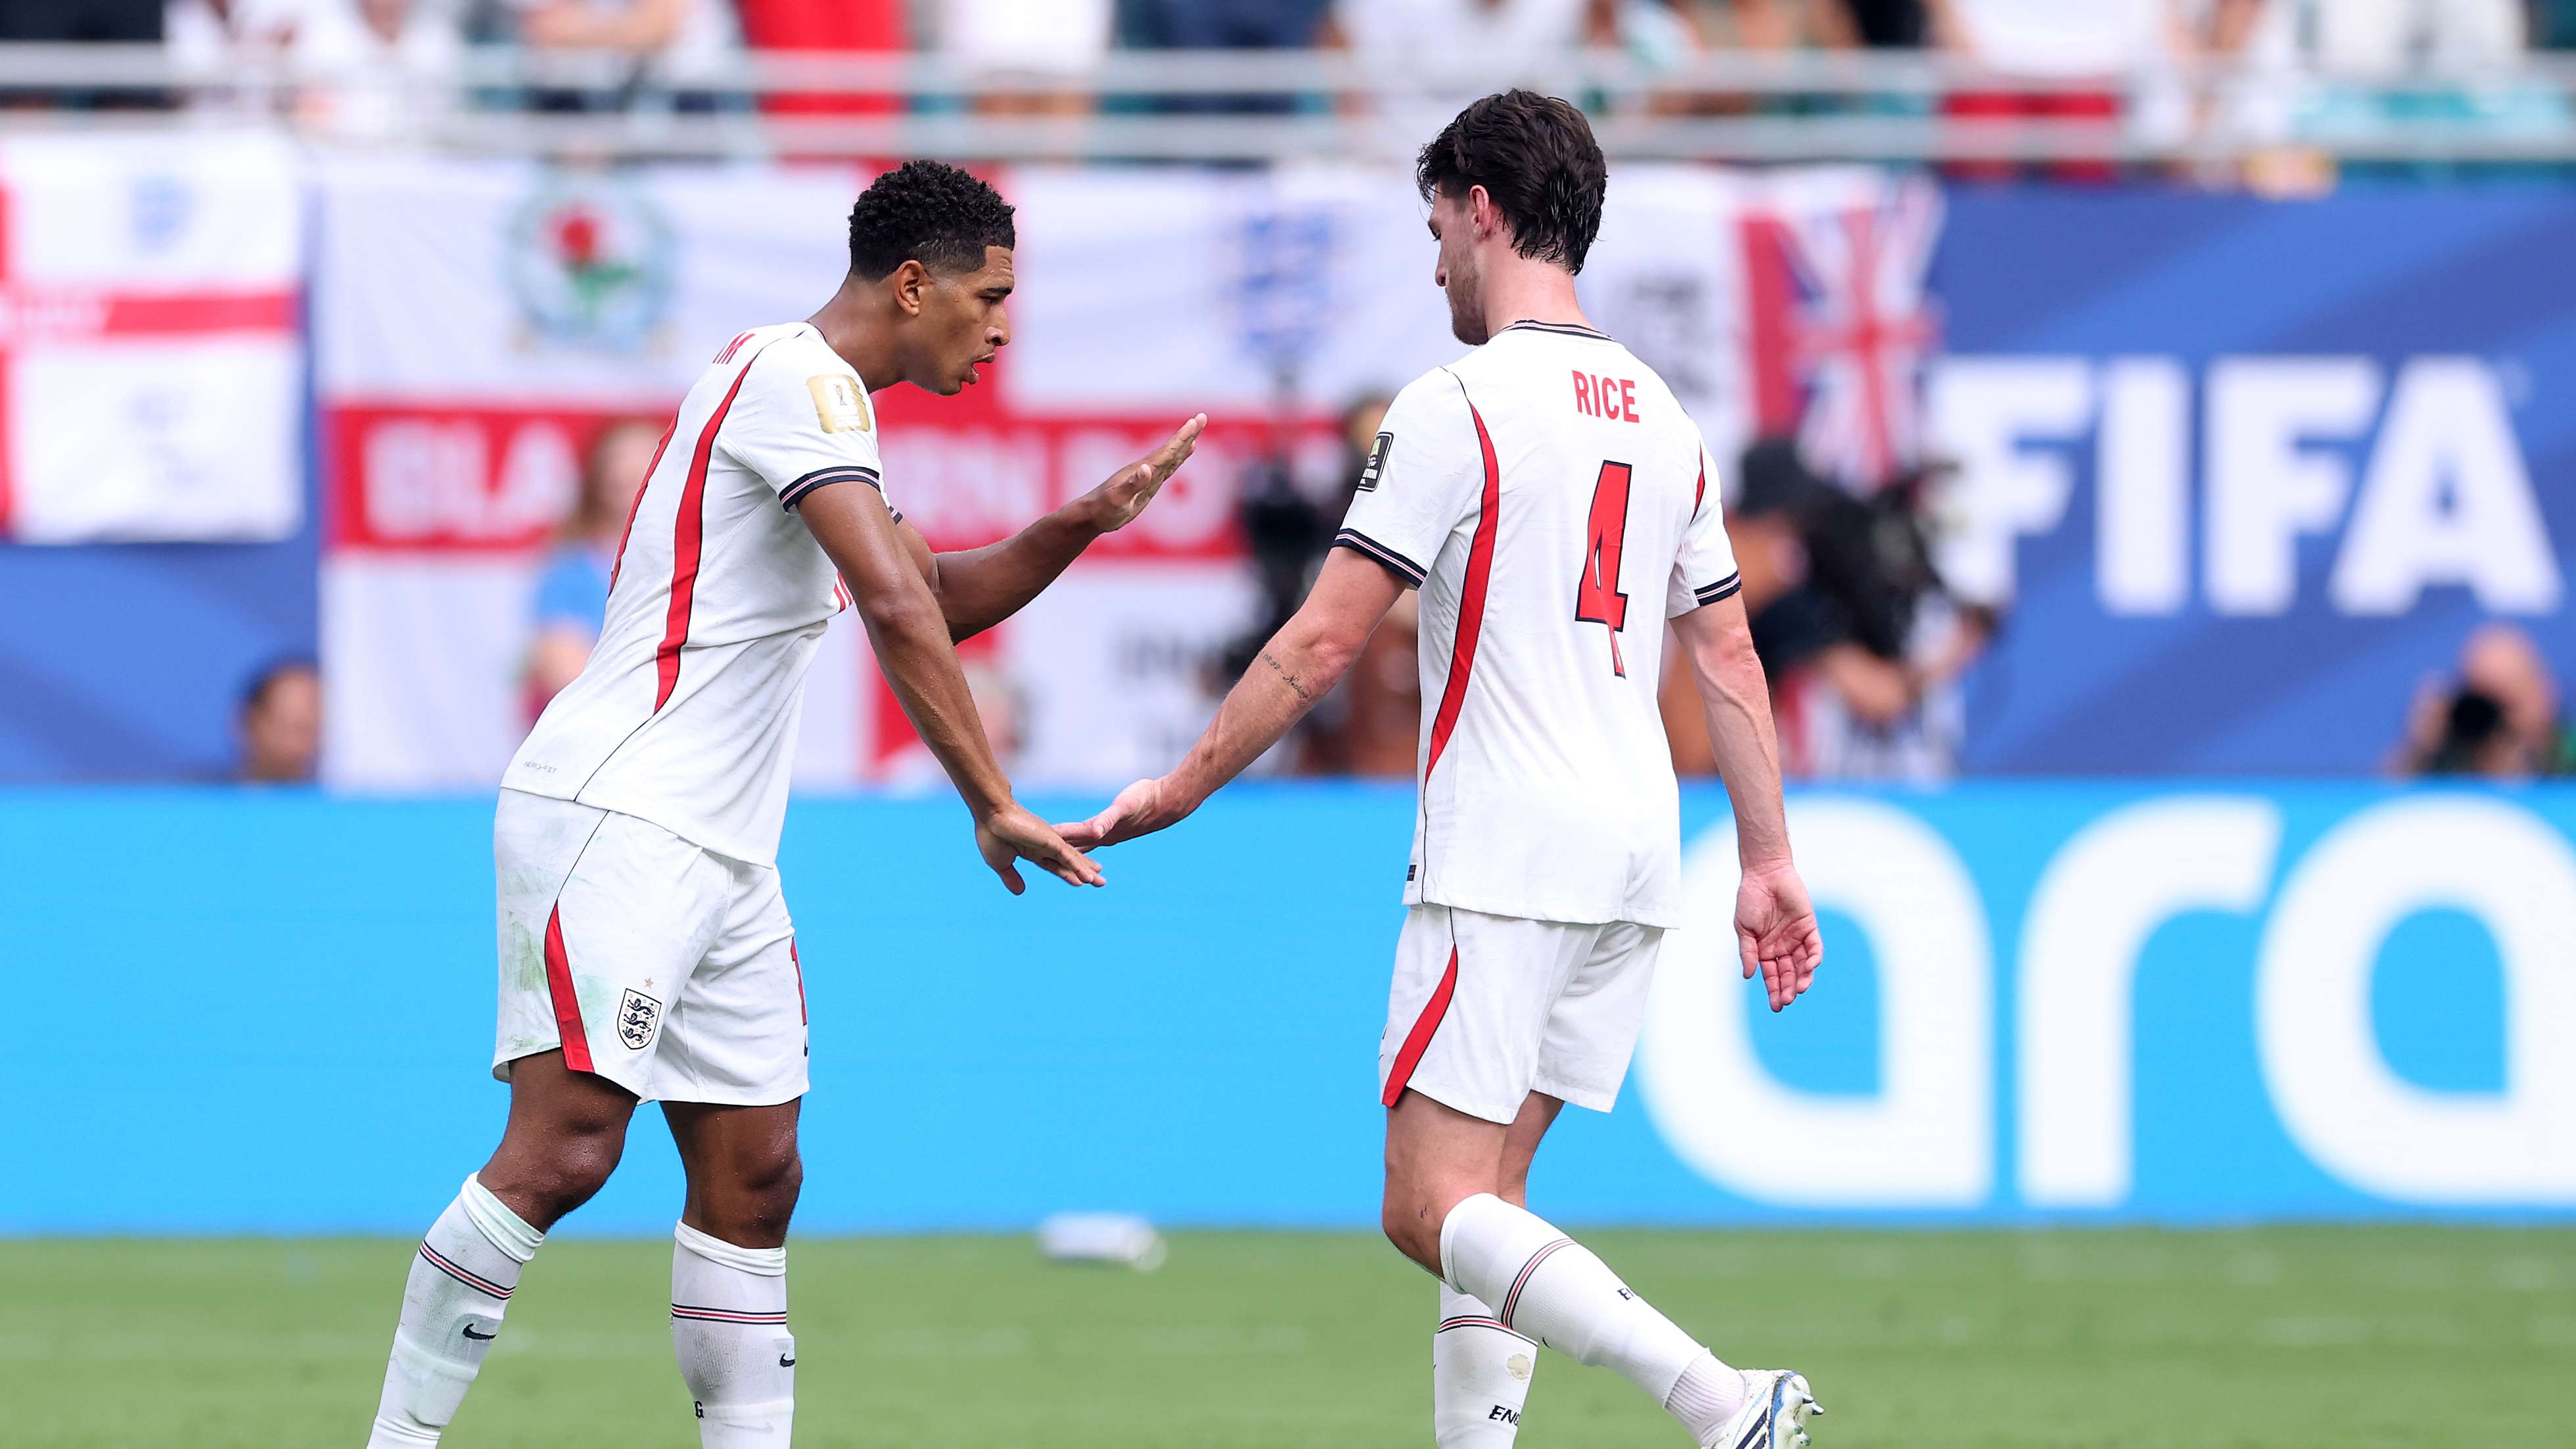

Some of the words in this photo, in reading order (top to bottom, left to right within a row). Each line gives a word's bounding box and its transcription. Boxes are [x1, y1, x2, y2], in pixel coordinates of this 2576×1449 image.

[1571, 370, 1640, 424] RICE
[1927, 356, 2563, 615] FIFA
[1575, 460, 1633, 679] 4
